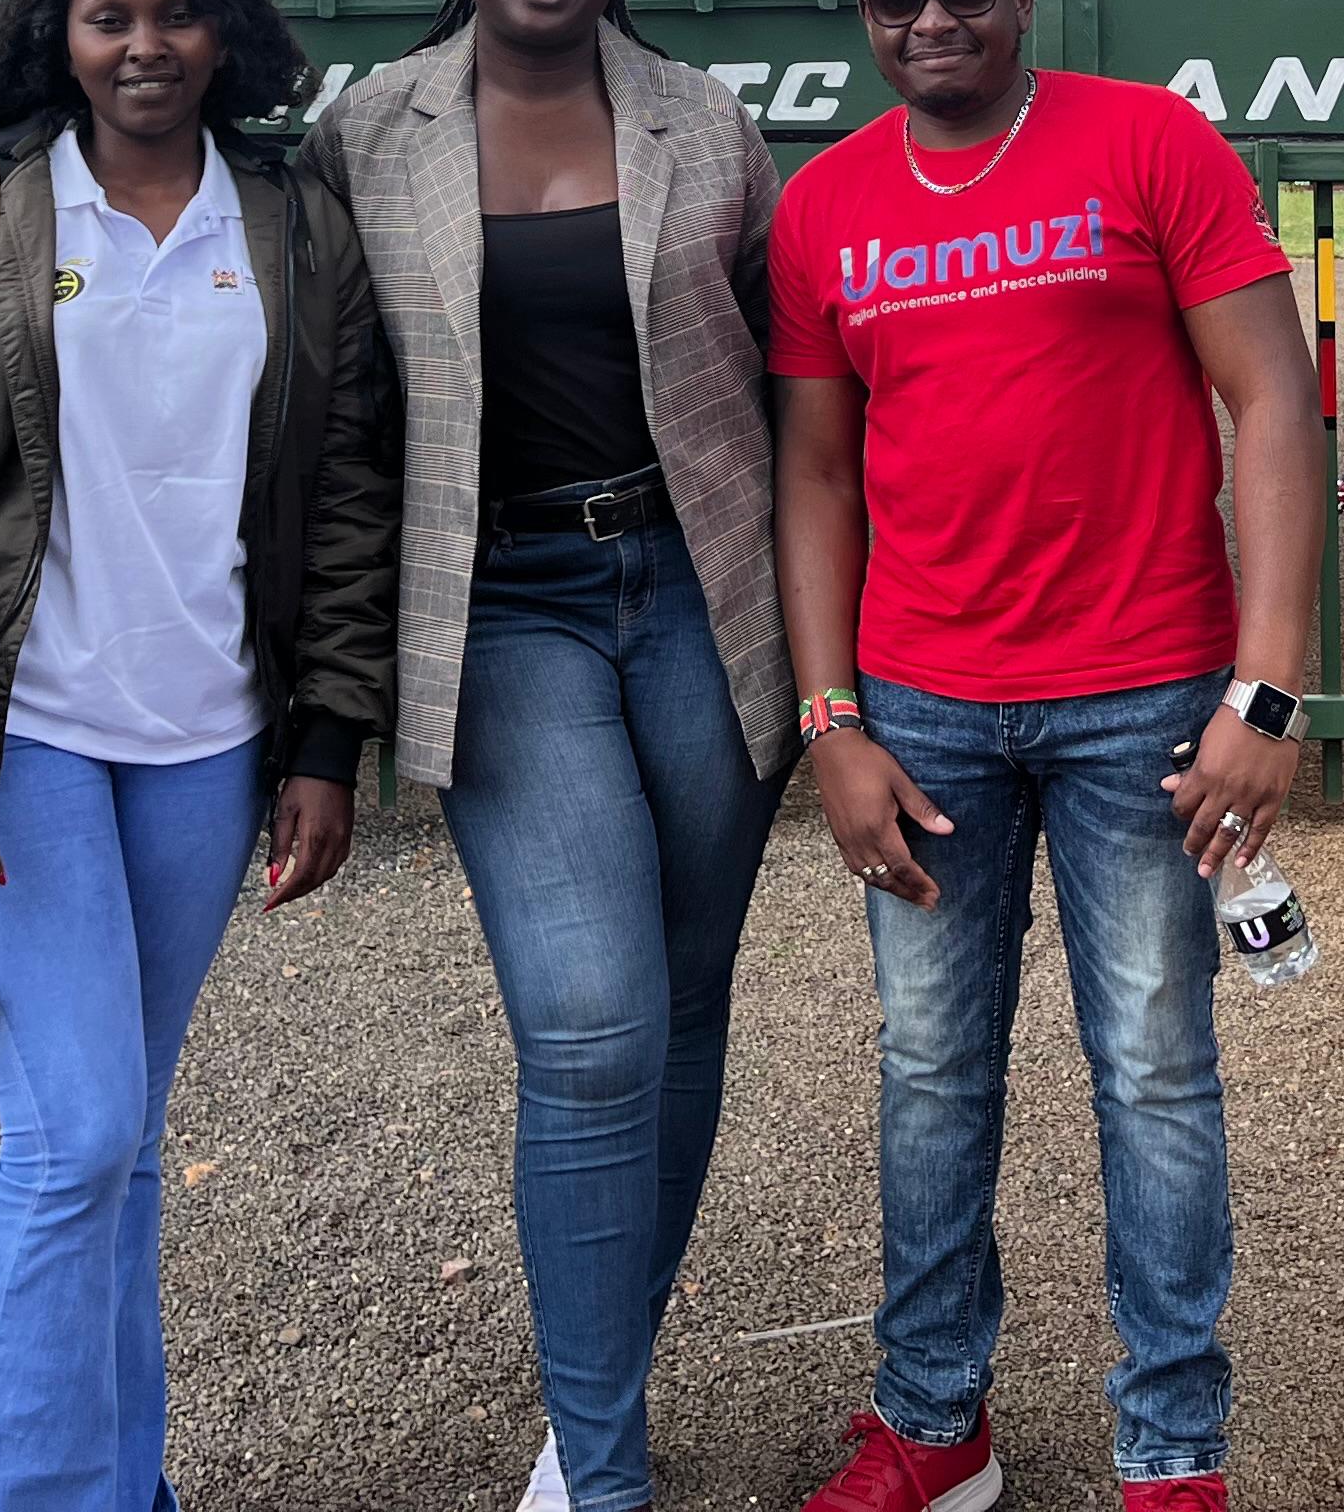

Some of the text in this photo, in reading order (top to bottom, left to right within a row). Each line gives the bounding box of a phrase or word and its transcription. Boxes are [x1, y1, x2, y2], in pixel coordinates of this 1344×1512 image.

[839, 197, 1105, 303] Uamuzi
[847, 266, 1108, 327] Digital Governance and Peacebuilding
